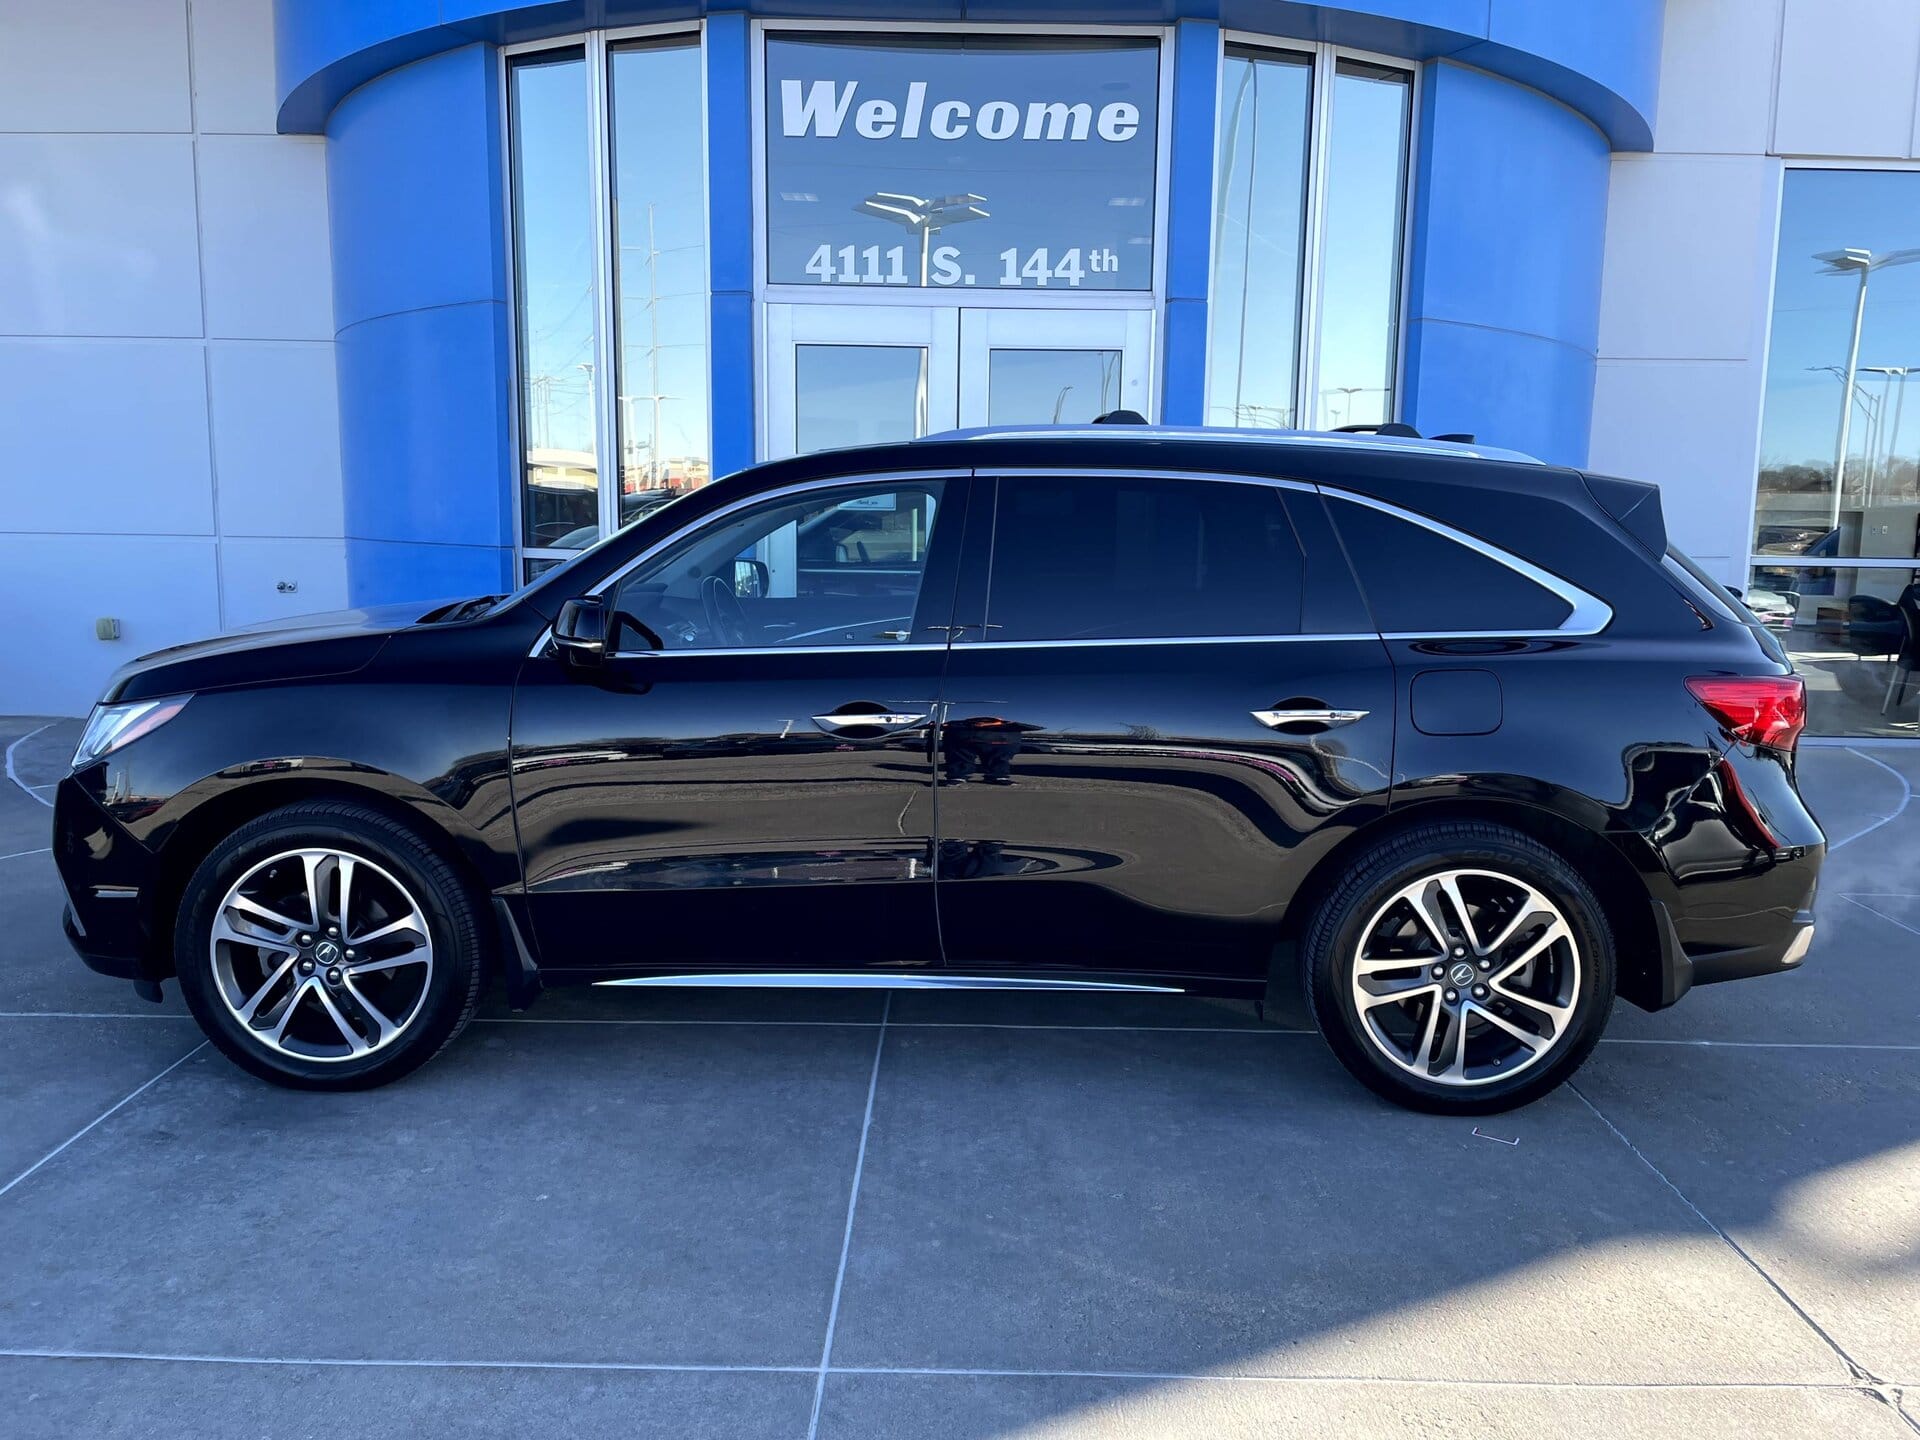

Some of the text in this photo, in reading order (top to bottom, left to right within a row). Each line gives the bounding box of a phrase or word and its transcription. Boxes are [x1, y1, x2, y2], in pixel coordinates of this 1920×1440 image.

[781, 80, 1140, 142] Welcome
[805, 244, 1119, 287] 4111 S. 144th
